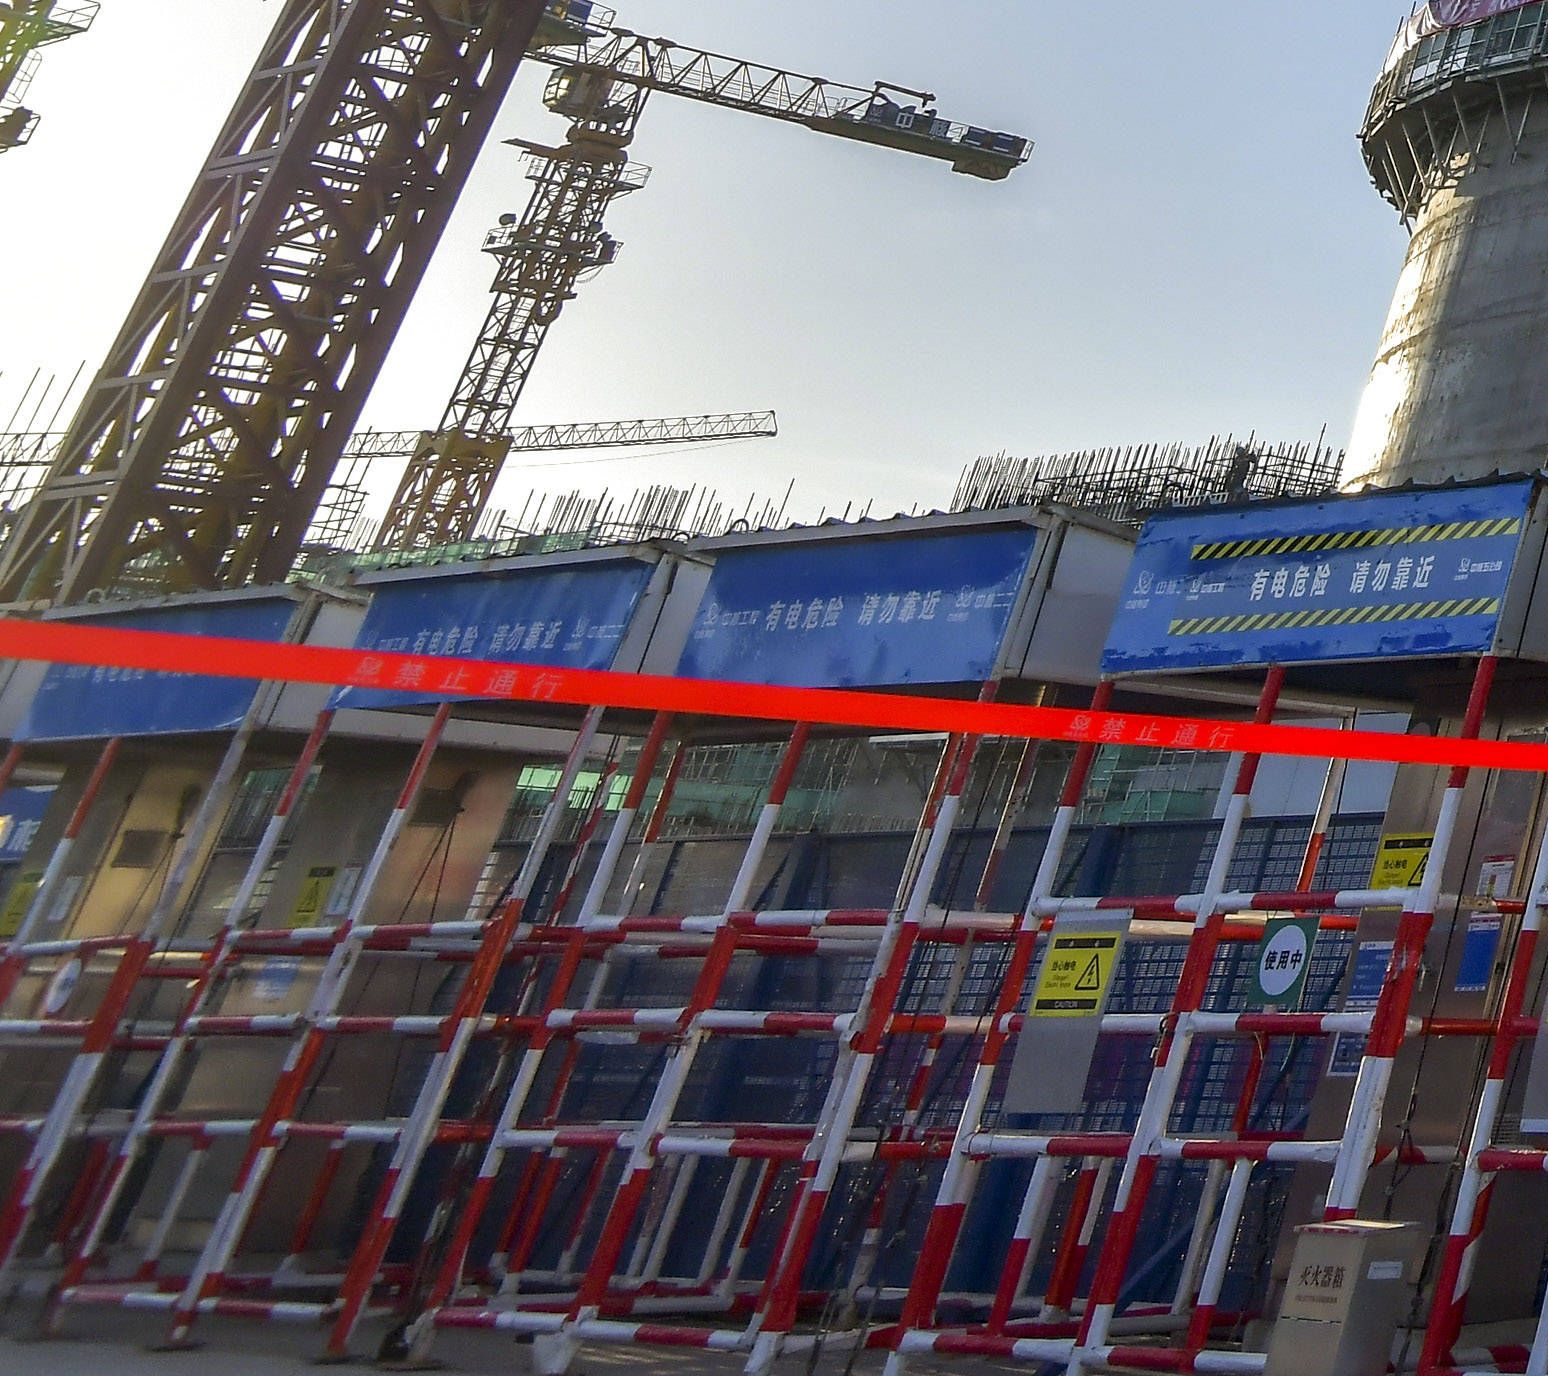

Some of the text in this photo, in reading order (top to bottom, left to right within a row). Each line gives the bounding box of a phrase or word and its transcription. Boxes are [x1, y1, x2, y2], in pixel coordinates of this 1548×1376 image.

[1249, 565, 1333, 602] 有电危险
[1349, 554, 1437, 594] 请勿靠近
[765, 595, 844, 632] 有电危险
[857, 589, 943, 626] 请勿靠近
[394, 659, 564, 699] 禁止通行
[1099, 716, 1237, 749] 禁止通行
[1264, 949, 1304, 972] 使用中
[1298, 1264, 1346, 1289] 灭火器箱
